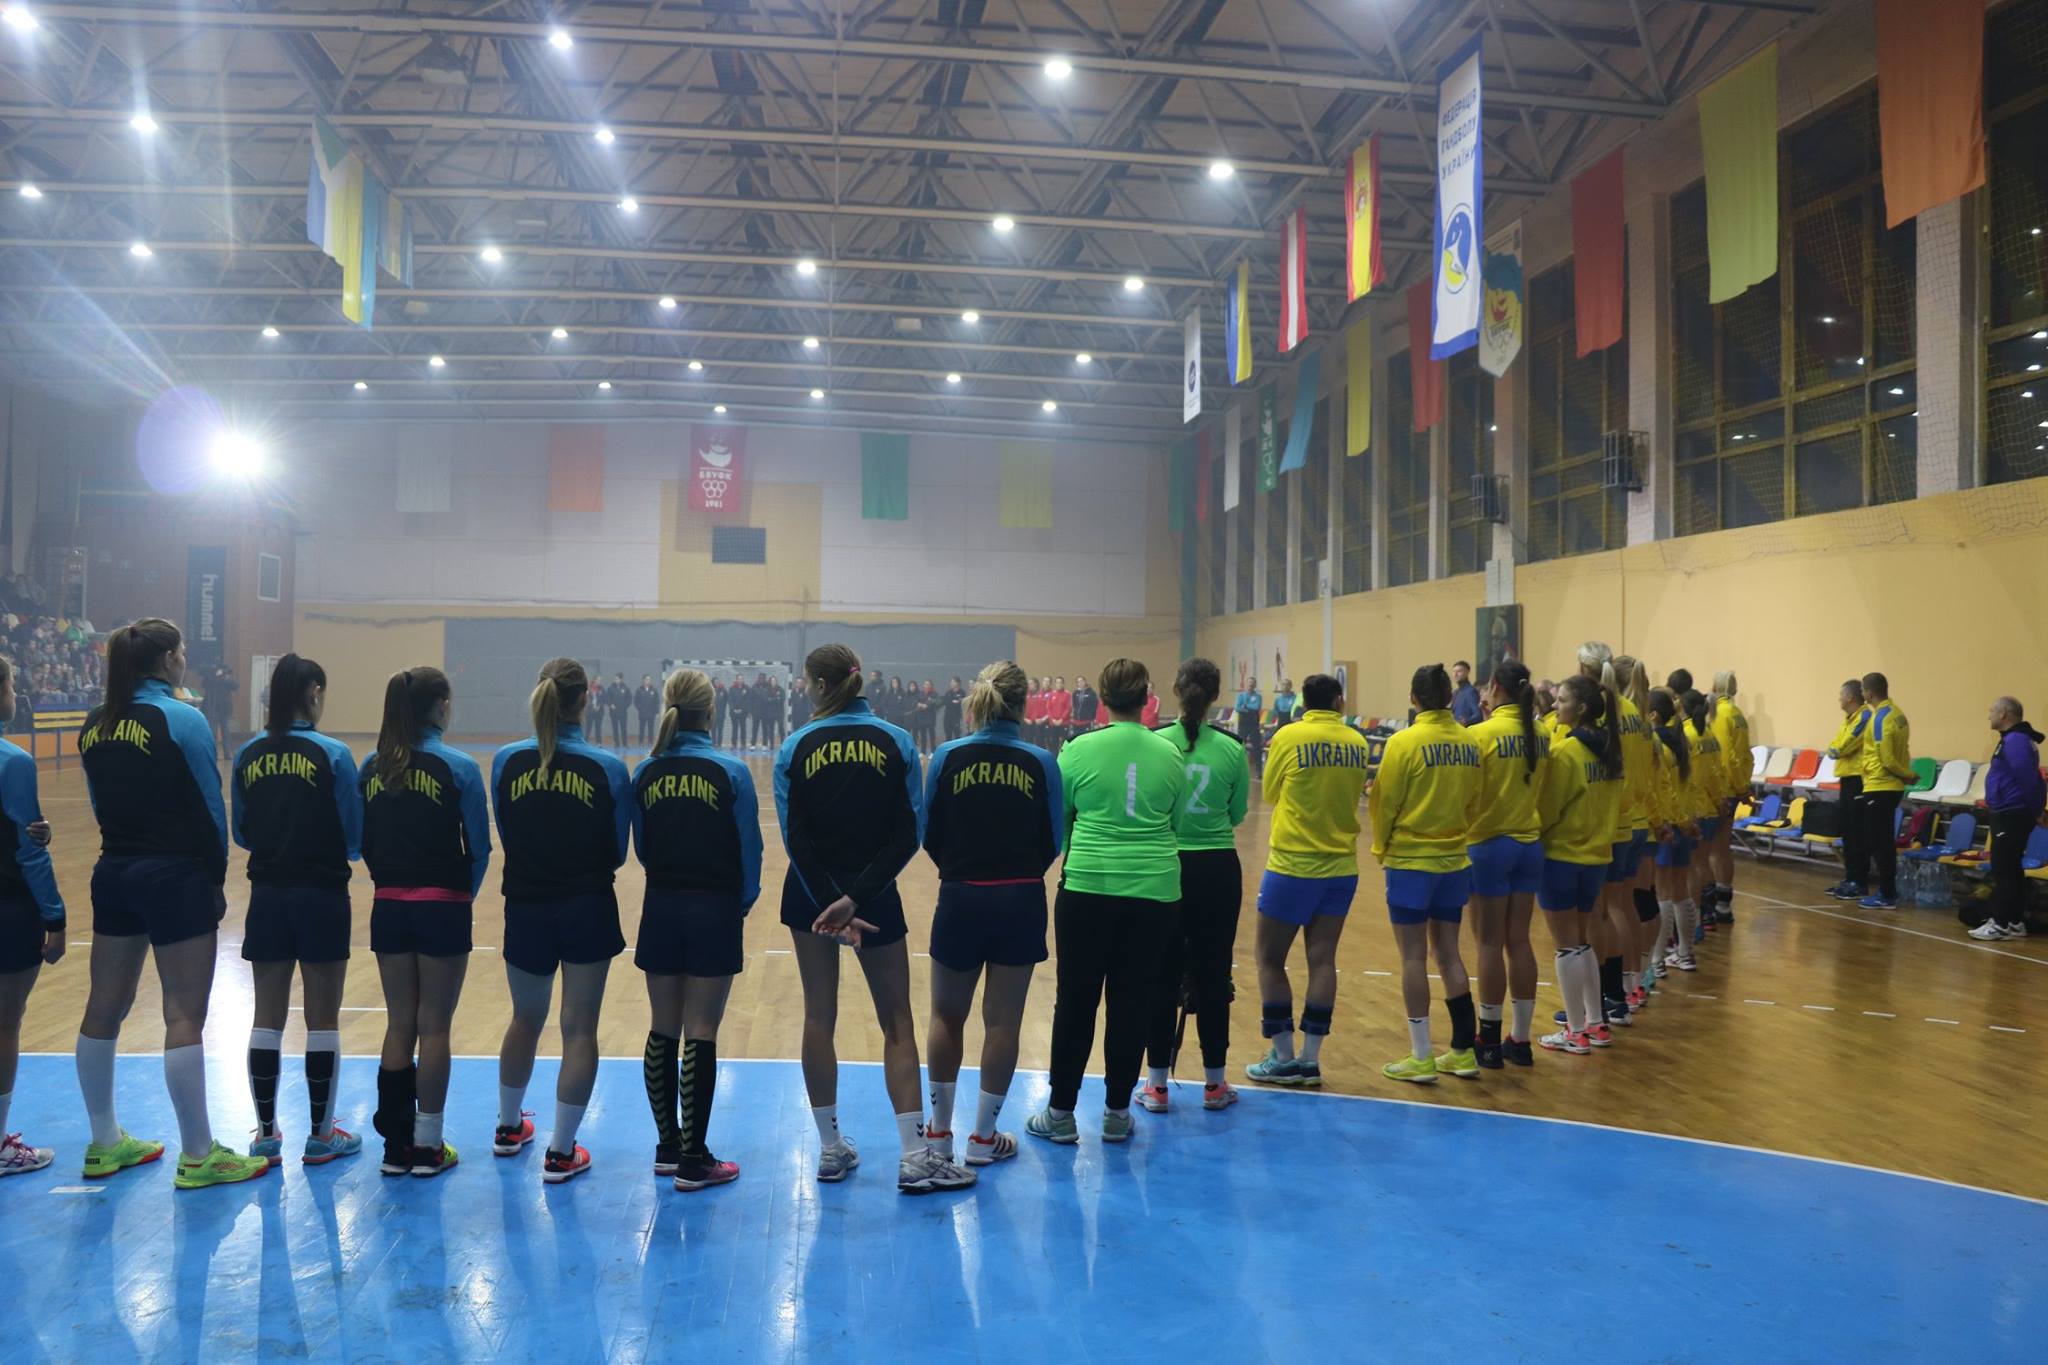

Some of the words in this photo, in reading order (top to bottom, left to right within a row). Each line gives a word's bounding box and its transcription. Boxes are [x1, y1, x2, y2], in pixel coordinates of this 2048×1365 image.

[201, 574, 219, 641] hummel
[81, 719, 151, 755] UKAINE
[1296, 742, 1367, 768] UKRAINE
[1421, 743, 1481, 768] UKRAINE
[243, 752, 317, 788] UKRAINE
[805, 740, 887, 780] UKRAINE
[644, 774, 720, 811] UKRAINE
[953, 761, 1035, 800] UKRAINE
[1125, 763, 1137, 817] 1
[1185, 763, 1211, 814] 2
